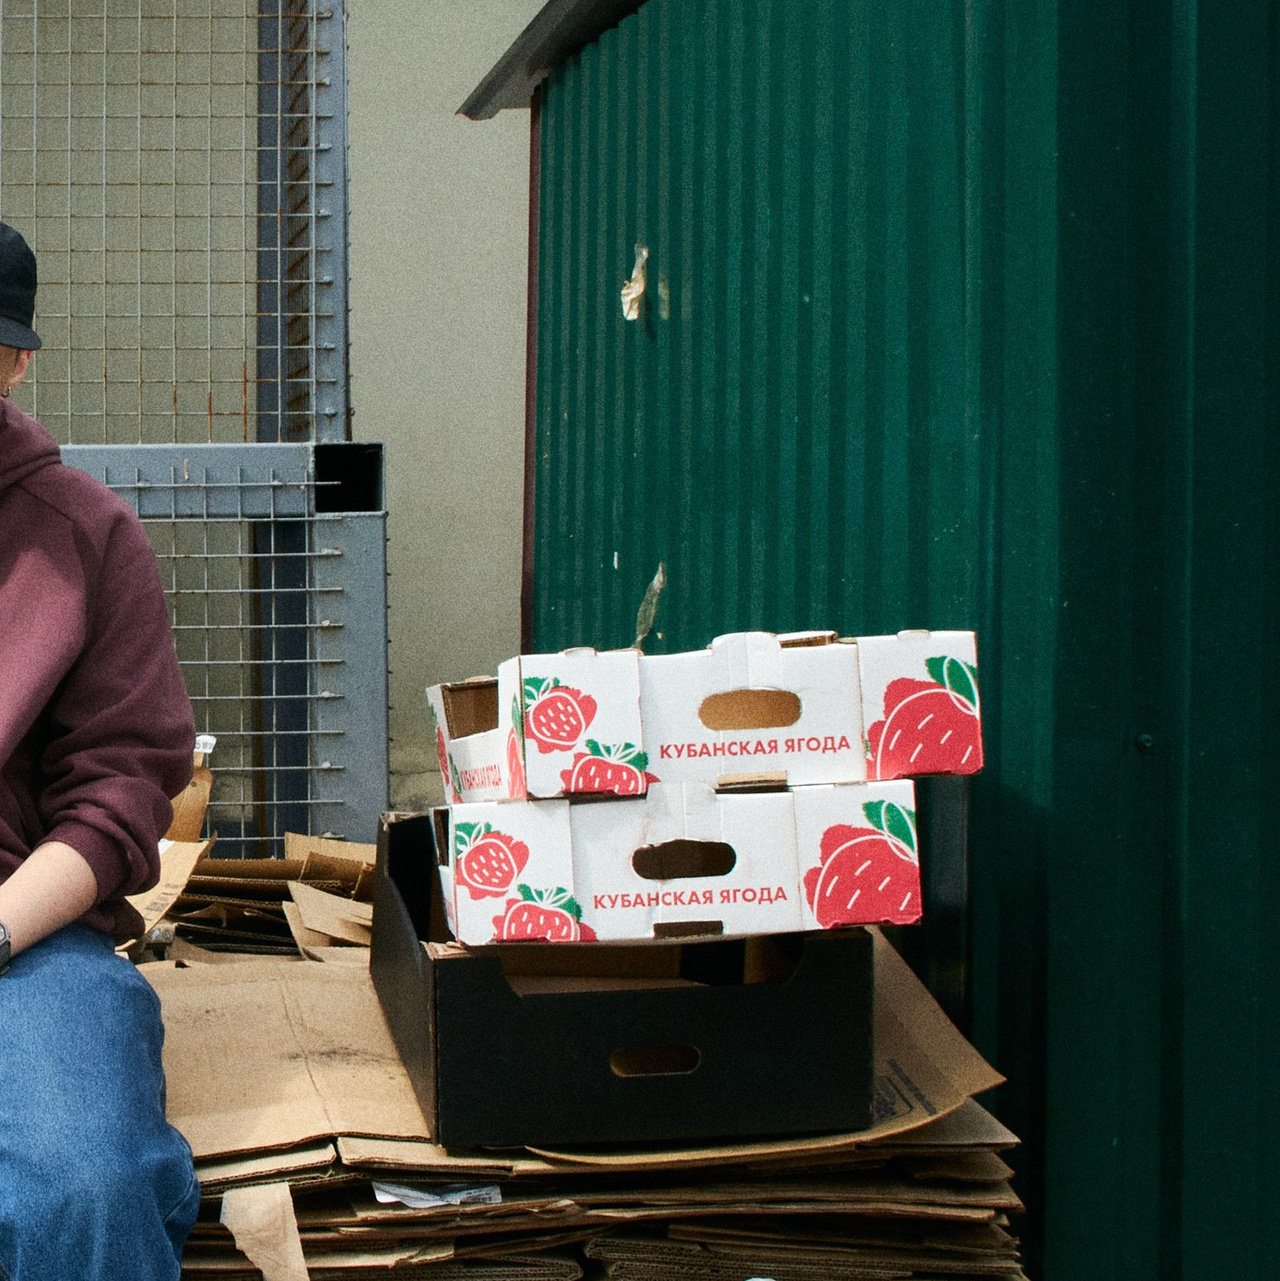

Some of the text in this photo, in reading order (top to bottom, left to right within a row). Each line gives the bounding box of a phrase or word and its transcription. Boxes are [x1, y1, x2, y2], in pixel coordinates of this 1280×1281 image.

[660, 735, 851, 759] КУБАНСКАЯ ЯГОДА
[593, 886, 787, 909] КУБАНСКАЯ ЯГОДА
